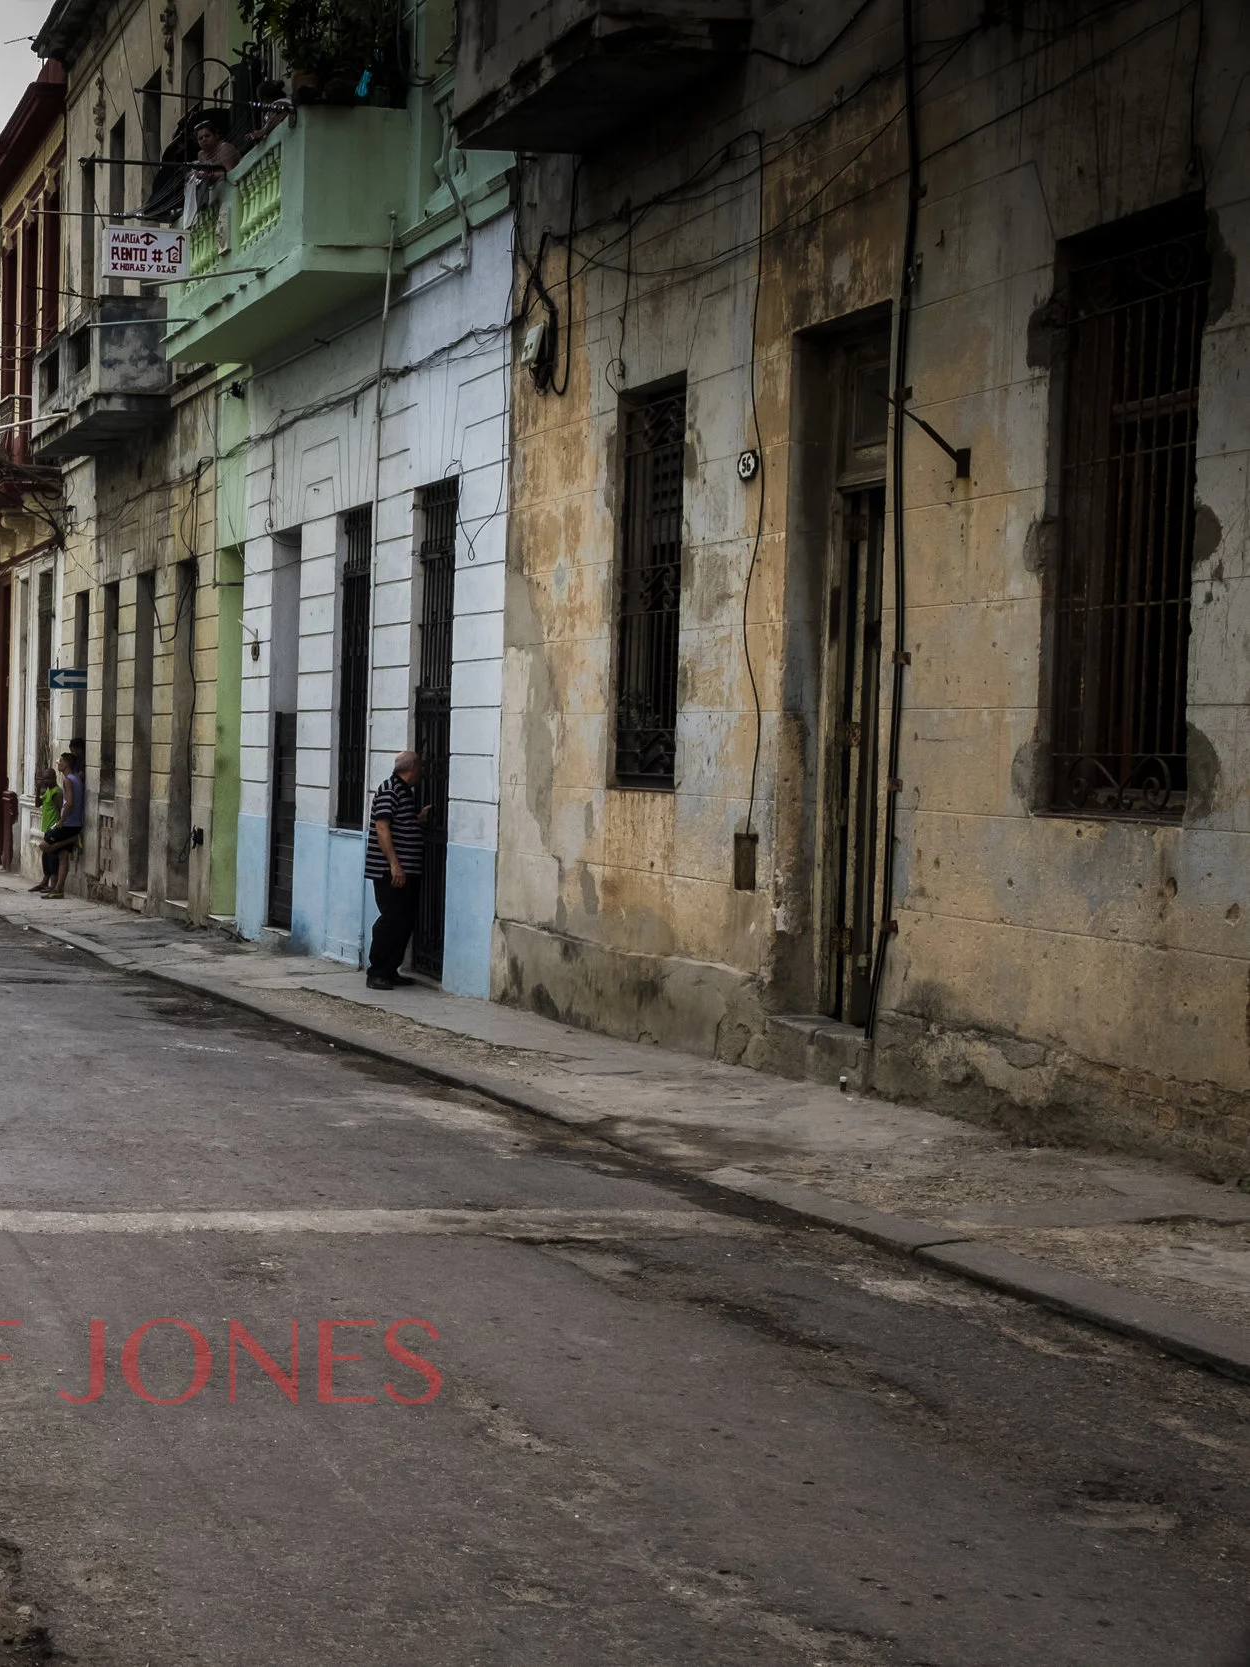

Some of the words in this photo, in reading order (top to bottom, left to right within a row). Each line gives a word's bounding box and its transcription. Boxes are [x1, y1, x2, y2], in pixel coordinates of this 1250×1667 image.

[111, 233, 140, 244] MARGA
[111, 246, 147, 261] RENTO
[120, 263, 145, 272] HORAS
[156, 265, 177, 273] DIAS
[741, 455, 751, 473] 56
